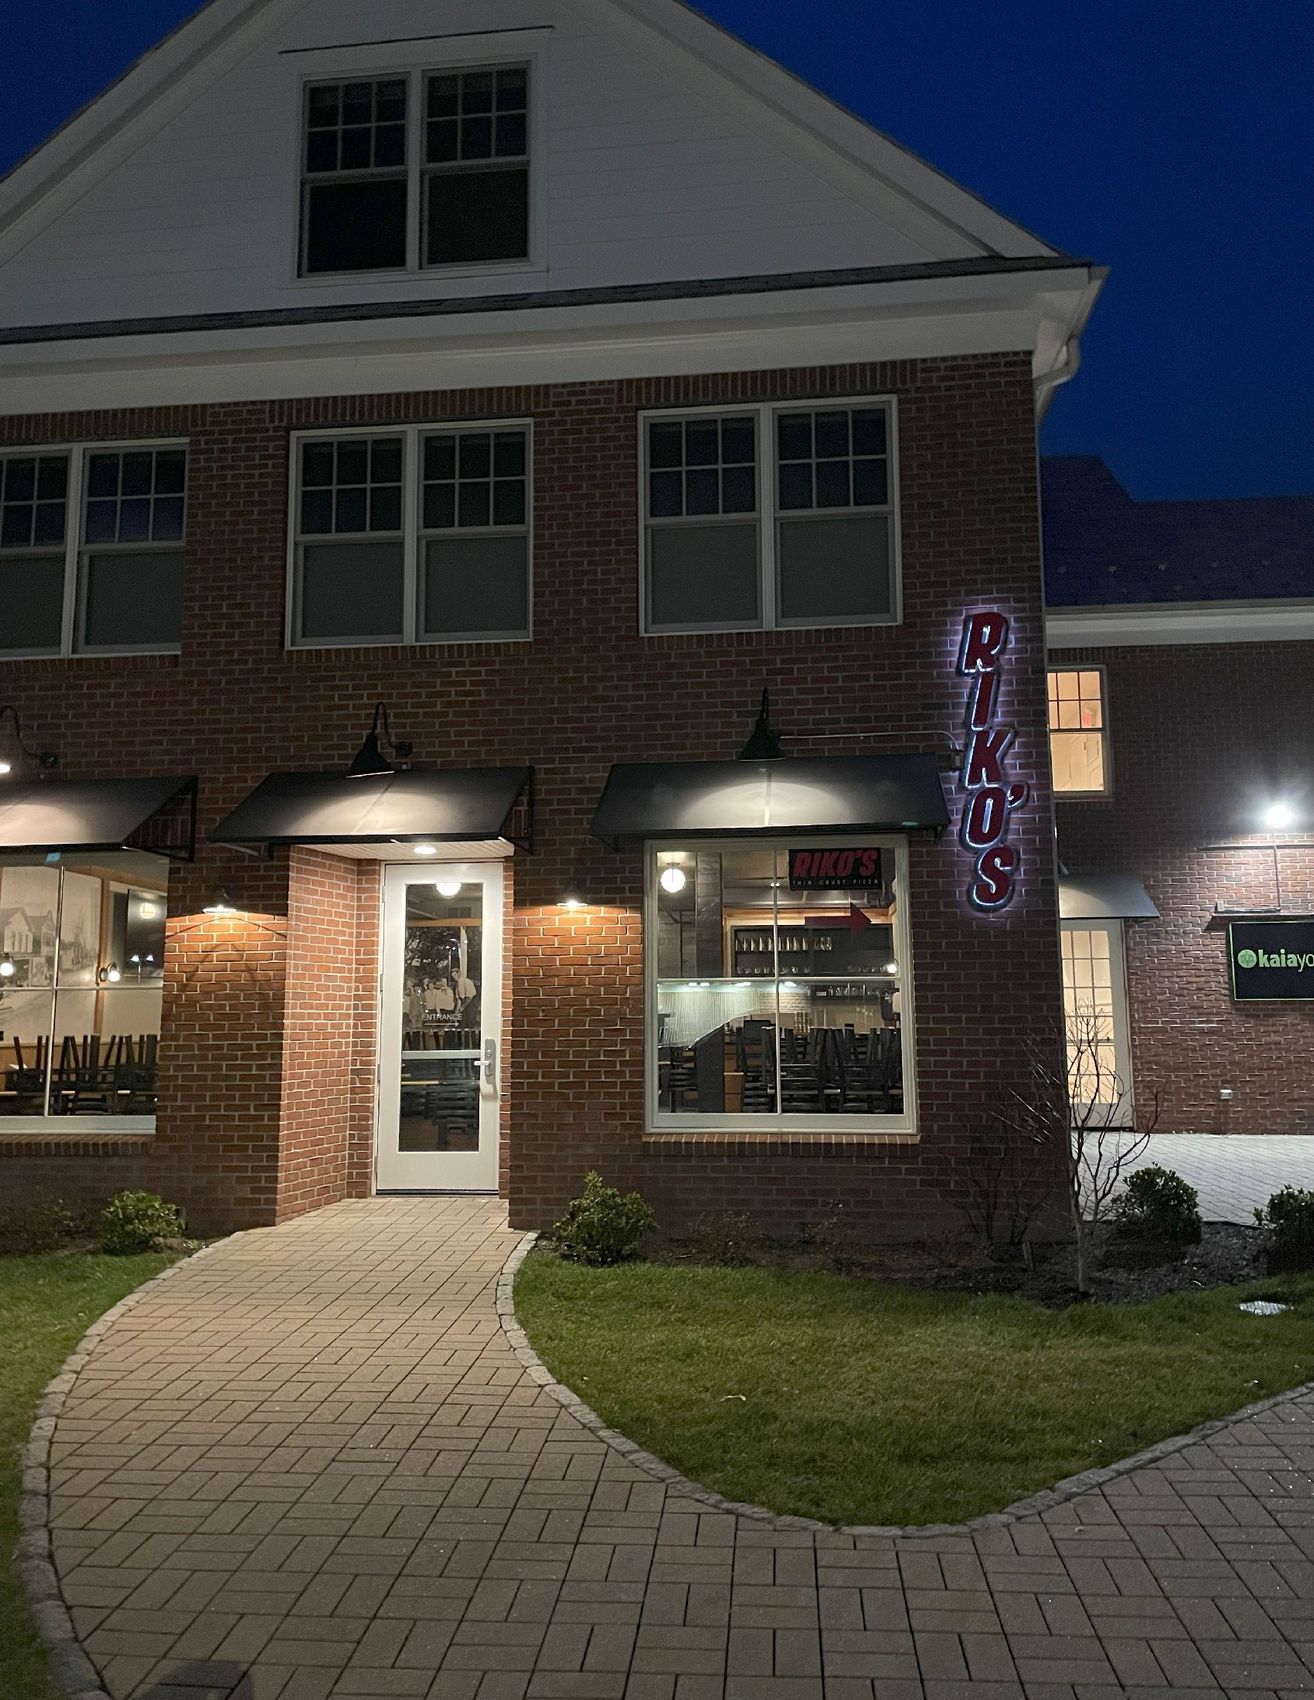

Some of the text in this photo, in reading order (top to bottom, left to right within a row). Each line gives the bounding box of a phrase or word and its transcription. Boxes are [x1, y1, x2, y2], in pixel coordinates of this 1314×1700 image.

[958, 612, 1029, 912] RIKO'S
[793, 850, 878, 877] RIKO'S
[1258, 948, 1314, 972] kaiayo
[421, 1013, 463, 1021] ENTRANCE
